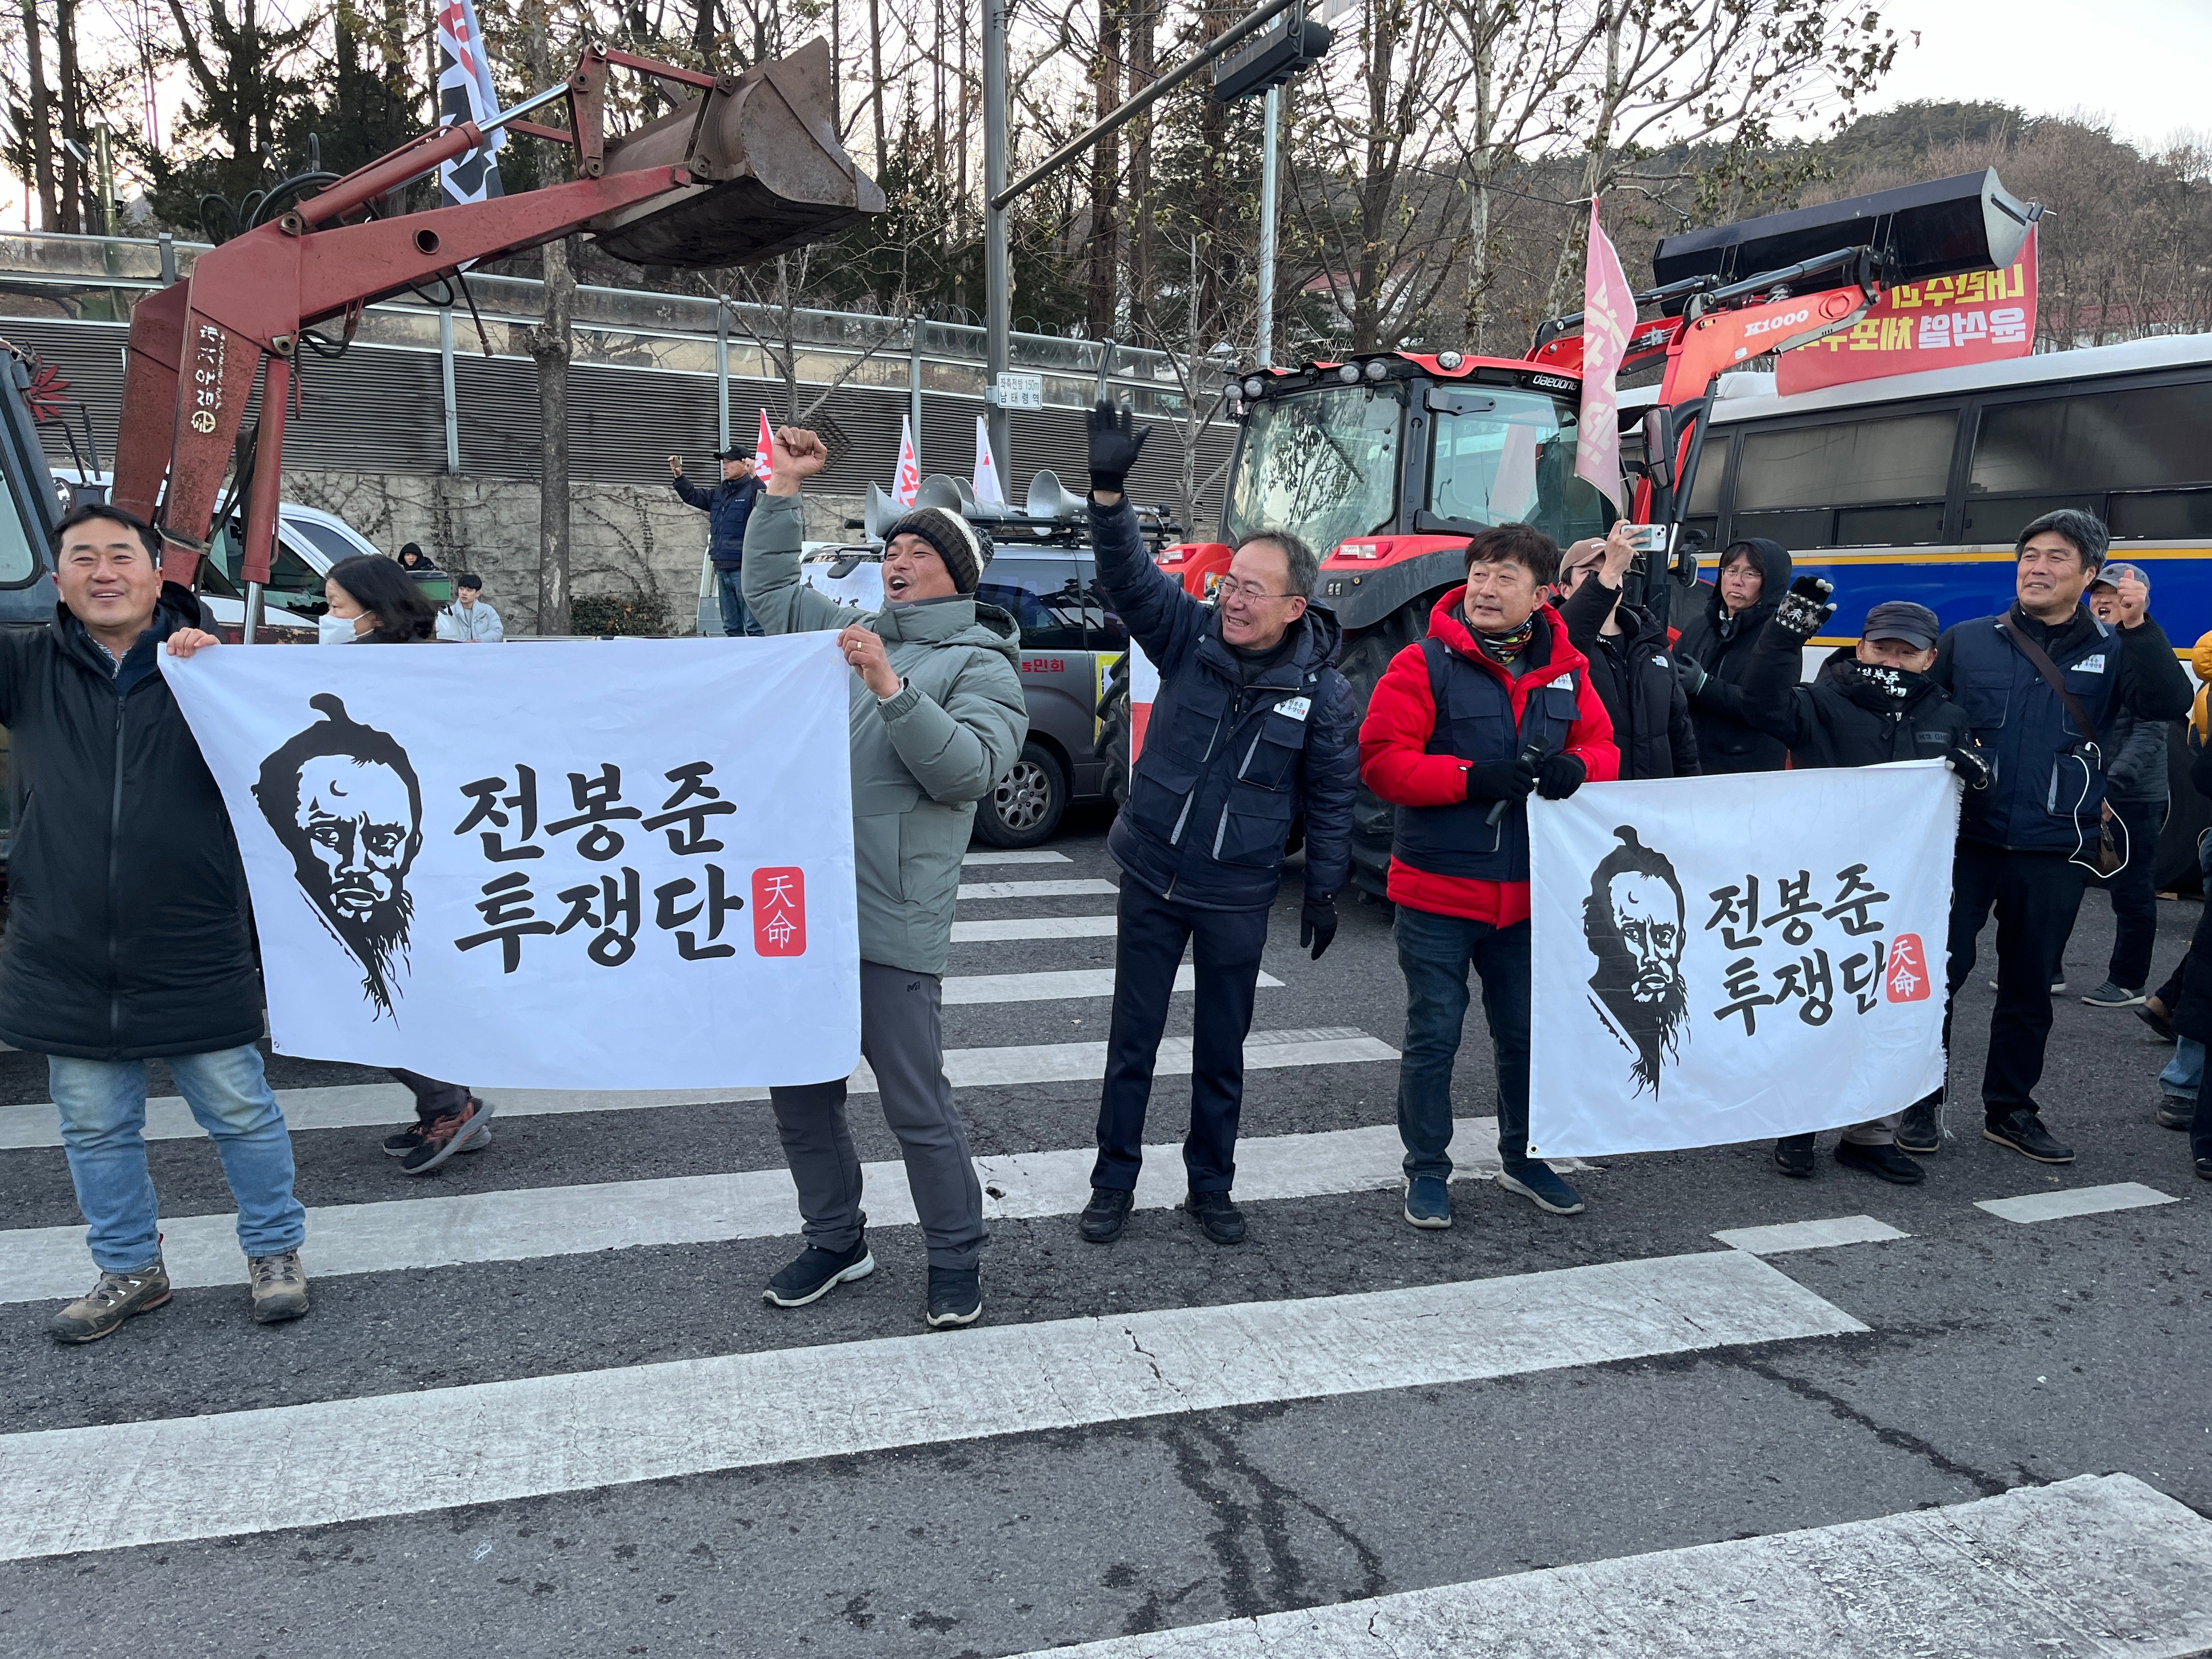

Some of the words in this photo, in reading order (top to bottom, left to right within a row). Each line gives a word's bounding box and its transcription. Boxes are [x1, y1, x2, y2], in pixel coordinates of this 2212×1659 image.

[1744, 309, 1809, 337] K1000
[1000, 377, 1023, 390] 좌측전방
[1025, 380, 1040, 391] 150m
[1000, 391, 1039, 405] 남태령역
[1532, 373, 1579, 391] daedong
[454, 761, 737, 862] 전봉준
[454, 863, 744, 974] 투쟁단
[761, 874, 798, 949] 天命
[1705, 863, 1890, 950] 전봉준
[1713, 940, 1887, 1037] 투쟁단
[1889, 939, 1921, 997] 天命
